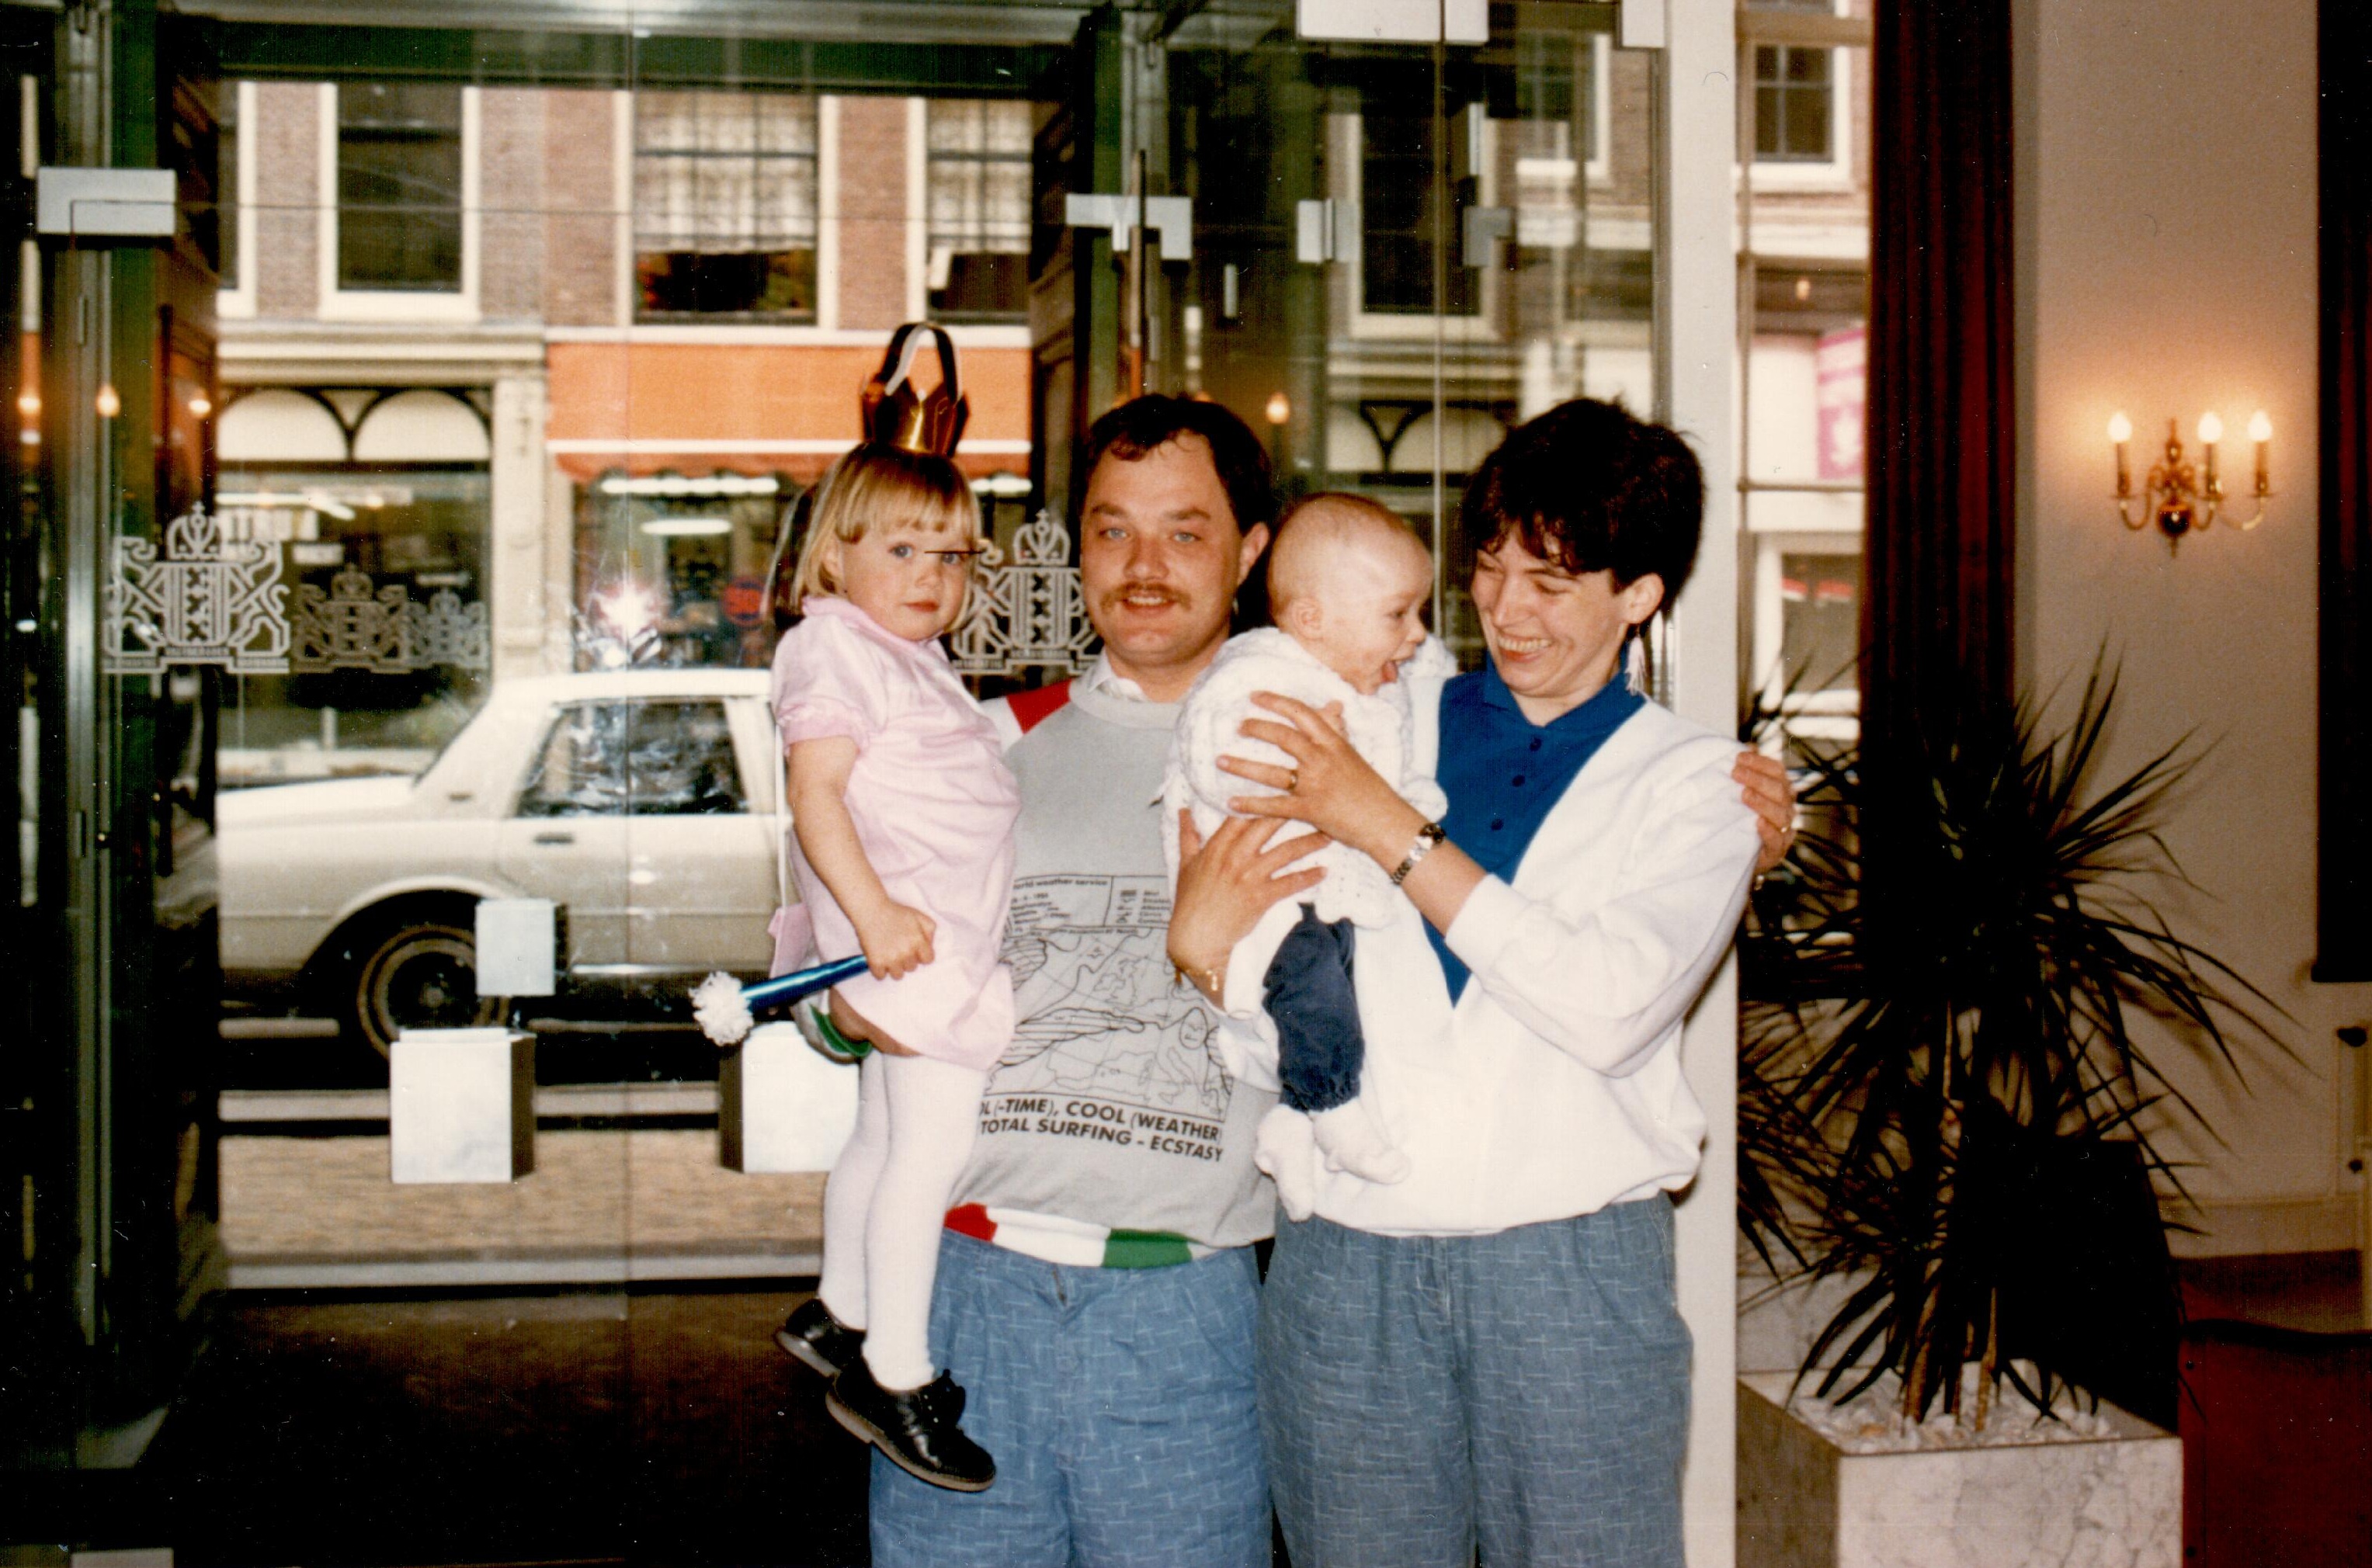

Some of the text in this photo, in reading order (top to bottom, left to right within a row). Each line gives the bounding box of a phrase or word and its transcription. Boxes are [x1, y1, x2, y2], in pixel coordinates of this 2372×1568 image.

[1036, 877, 1073, 886] weather
[981, 1117, 1030, 1136] TOTAL
[1037, 1118, 1132, 1145] SURFING
[1150, 1135, 1224, 1162] ECSTASY
[994, 1098, 1059, 1117] (-TIME),
[1066, 1100, 1125, 1123] COOL
[1130, 1112, 1222, 1146] (WEATHER)
